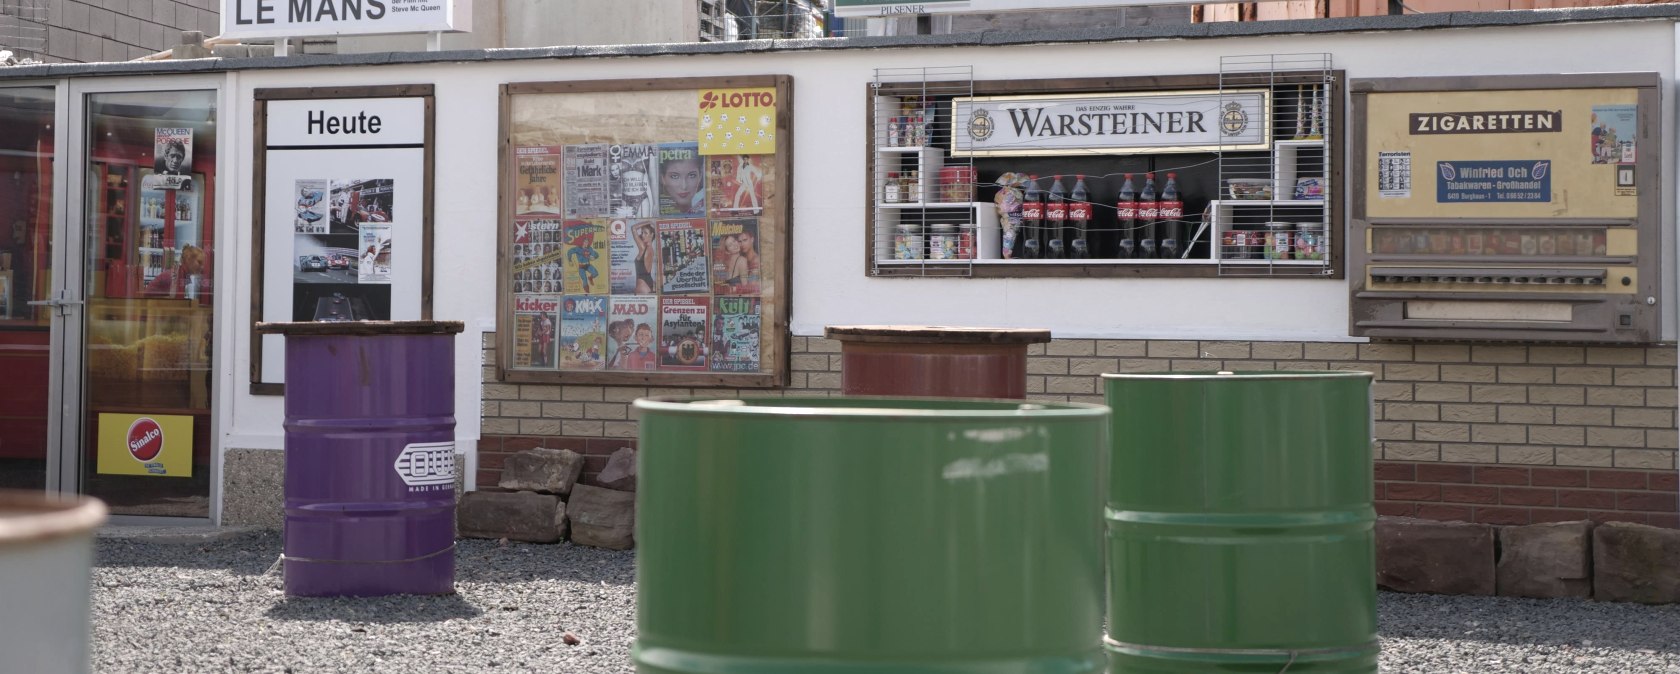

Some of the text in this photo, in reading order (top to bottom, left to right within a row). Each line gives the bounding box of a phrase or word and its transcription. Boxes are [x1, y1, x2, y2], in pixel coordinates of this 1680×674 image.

[236, 0, 386, 25] LE MANS
[420, 4, 441, 12] Queen
[881, 5, 926, 15] PILSENER
[307, 110, 382, 135] Heute
[1006, 108, 1208, 138] WARSTEINER
[1417, 114, 1553, 131] ZIGARETTEN
[623, 145, 655, 158] EMMA
[660, 149, 692, 164] petra
[519, 165, 557, 175] Gefährliche
[581, 165, 602, 177] Mark
[1459, 167, 1528, 178] Winfried Och
[529, 174, 547, 184] Jahre
[530, 221, 560, 231] stern
[567, 225, 605, 243] SUPERMAN
[671, 281, 706, 290] gesellschaft
[515, 298, 558, 312] kicker
[612, 303, 649, 315] MAD
[663, 306, 696, 314] Grenzen
[719, 297, 750, 314] kult
[663, 319, 706, 329] Asylanten?
[679, 314, 691, 322] für
[130, 428, 160, 452] Sinalco
